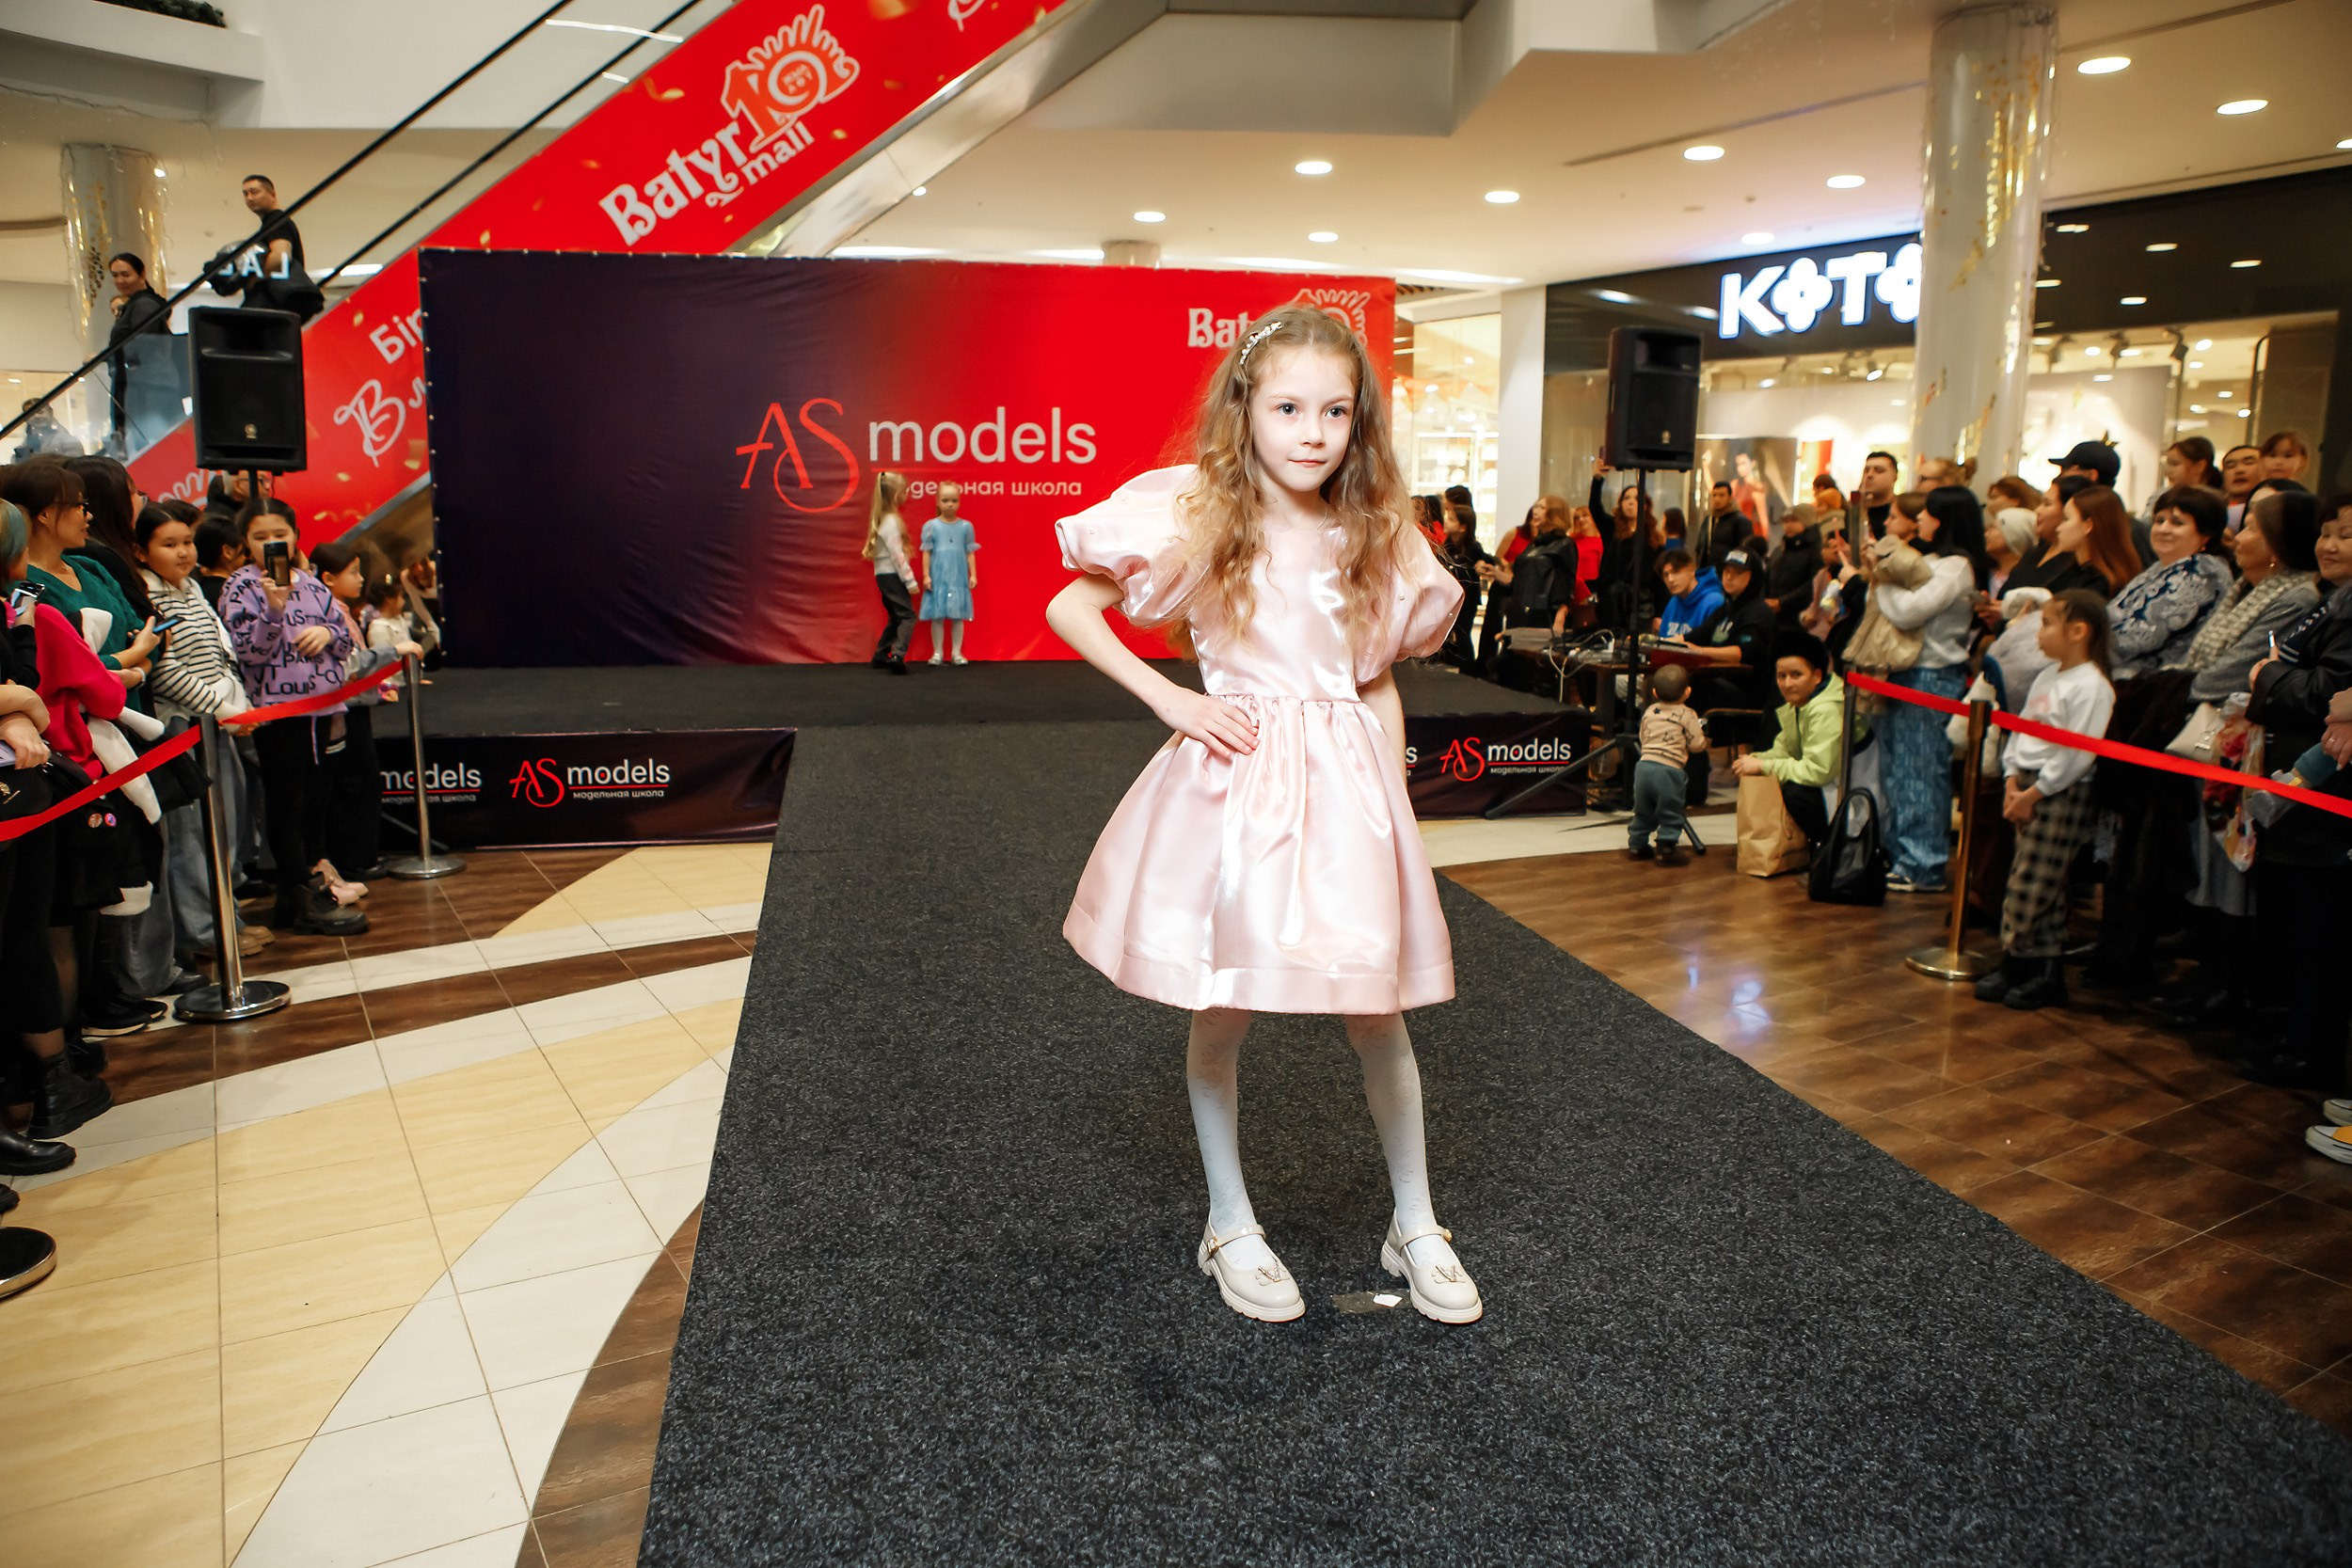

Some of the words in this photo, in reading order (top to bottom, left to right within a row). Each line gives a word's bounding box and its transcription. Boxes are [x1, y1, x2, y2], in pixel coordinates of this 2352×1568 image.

[739, 120, 816, 186] mall
[598, 120, 748, 246] Batyr
[1187, 308, 1257, 348] Bat
[736, 398, 860, 514] AS
[868, 406, 1098, 465] models
[1011, 481, 1082, 497] школа
[509, 757, 564, 808] AS
[567, 758, 670, 785] models
[1439, 736, 1486, 782] AS
[1487, 737, 1572, 761] models
[573, 791, 629, 800] модельная
